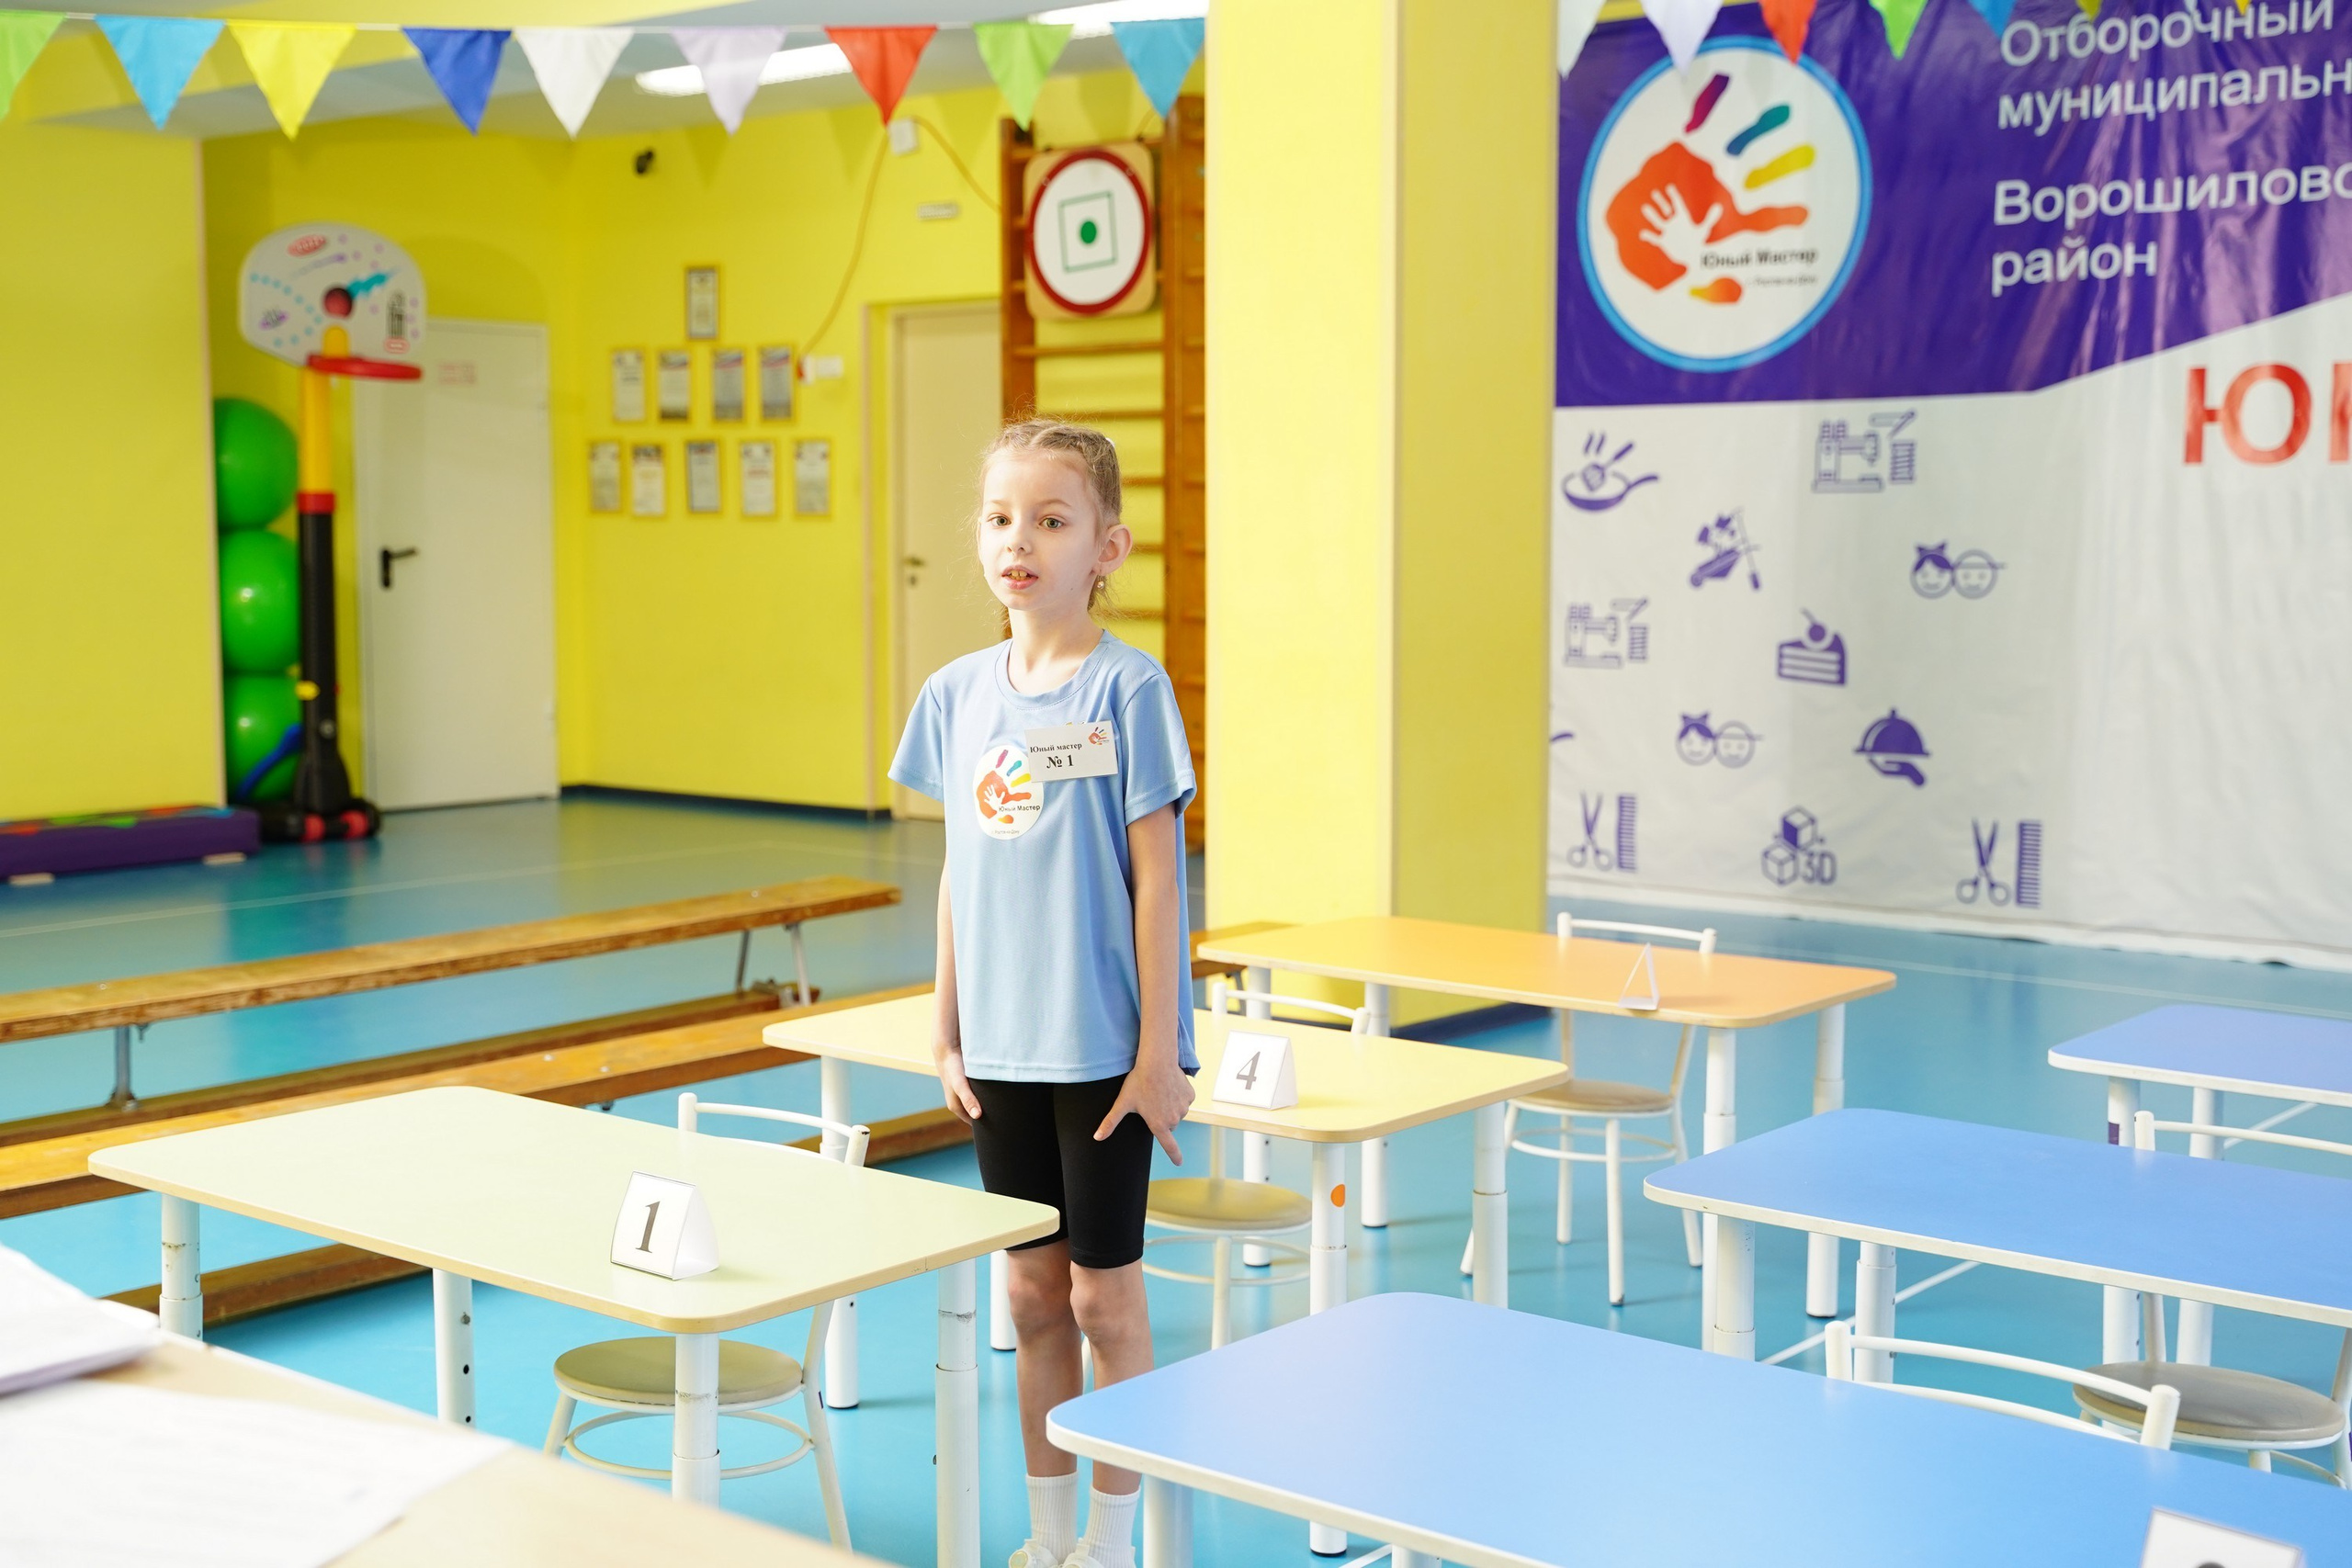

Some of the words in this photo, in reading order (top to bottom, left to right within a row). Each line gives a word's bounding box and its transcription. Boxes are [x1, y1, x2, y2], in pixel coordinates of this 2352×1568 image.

[2000, 0, 2334, 66] Отборочный
[1998, 58, 2352, 136] муниципальн
[1992, 235, 2157, 298] район
[1030, 744, 1055, 752] Юный
[1046, 755, 1062, 769] №
[1067, 754, 1074, 766] 1
[1802, 850, 1838, 886] 3D
[1236, 1051, 1261, 1090] 4
[635, 1201, 661, 1253] 1
